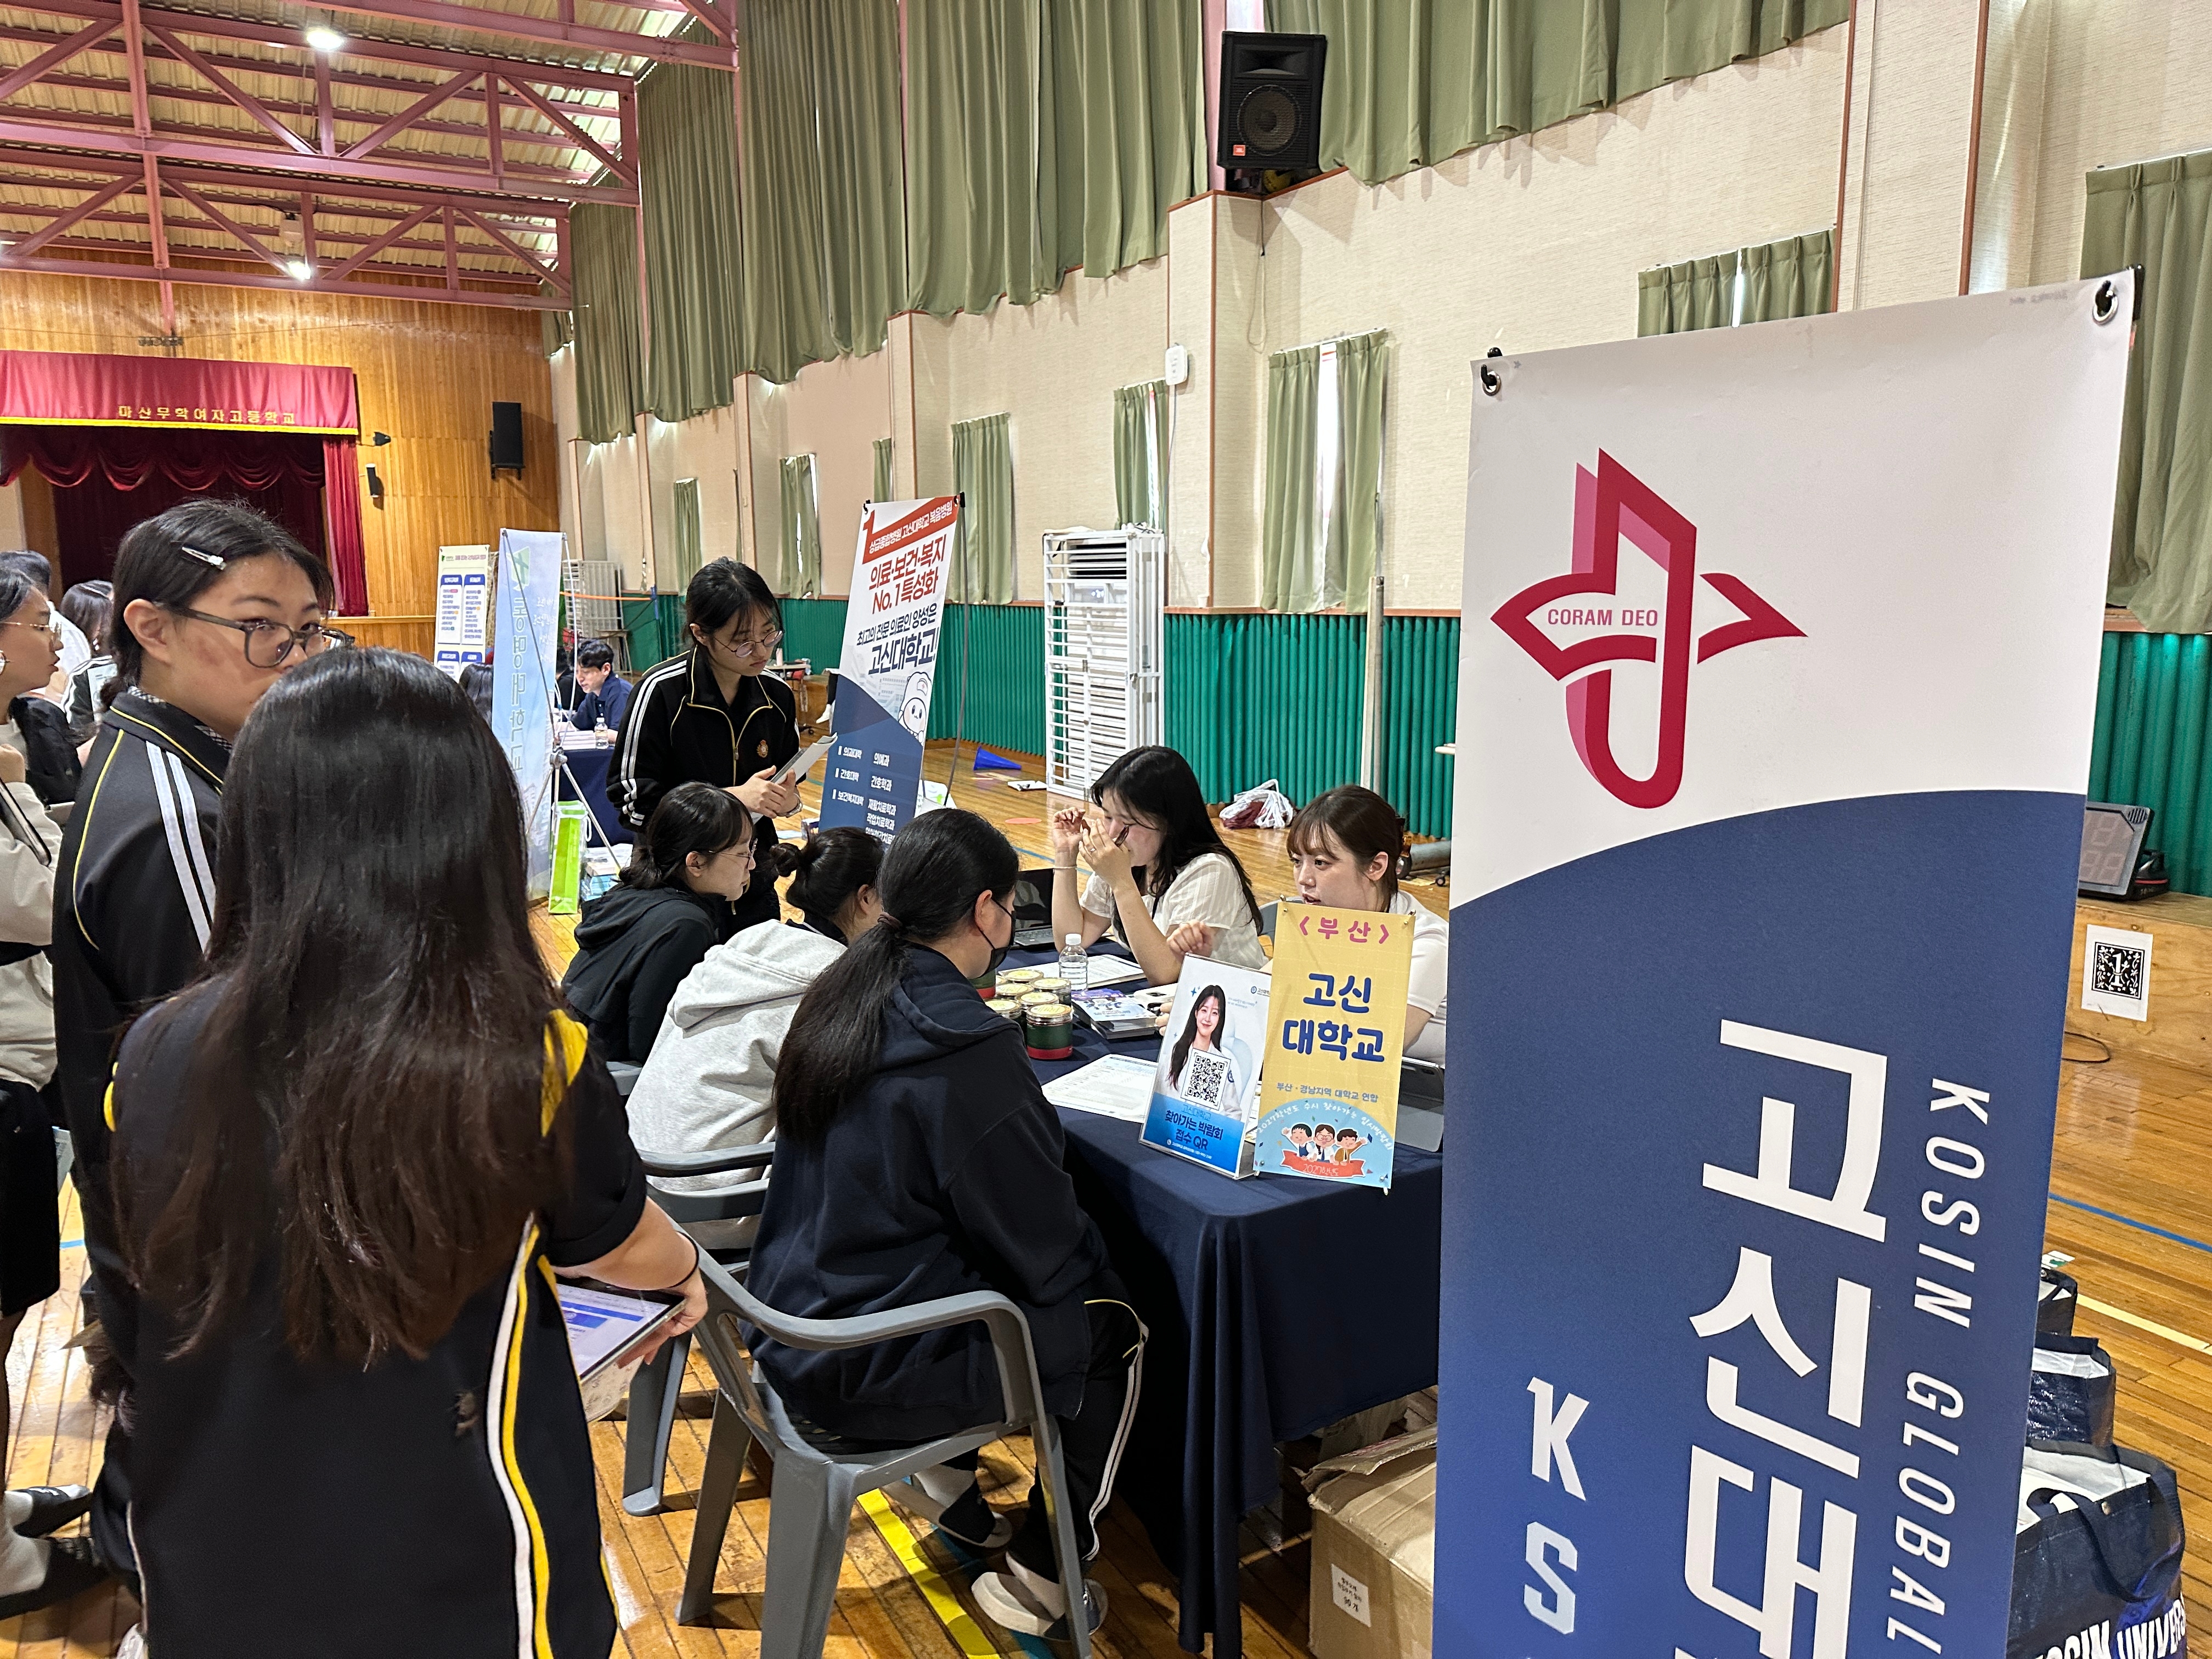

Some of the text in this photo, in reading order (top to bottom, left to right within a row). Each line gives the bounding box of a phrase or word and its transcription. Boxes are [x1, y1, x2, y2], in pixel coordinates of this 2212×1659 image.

[118, 405, 295, 424] 마산무학여자고등학교
[869, 500, 952, 554] 상급종합병원 고신대학교 복음병원
[856, 603, 937, 646] 최고의 전문 의료인 양성은
[1548, 609, 1658, 626] CORAM DEO
[868, 627, 939, 675] 고신대학교!
[843, 747, 862, 759] 의과대학
[873, 752, 890, 767] 의예과
[840, 769, 860, 782] 간호대학
[871, 776, 892, 792] 간호학과
[1303, 973, 1372, 1013] 고신
[1282, 1019, 1385, 1062] 대학교
[1277, 1082, 1293, 1092] 부산
[1300, 1084, 1331, 1097] 경남지역
[1335, 1090, 1359, 1099] 대학교
[1362, 1092, 1379, 1103] 연합
[1165, 1110, 1223, 1140] 찾아가는 박람회
[1181, 1104, 1211, 1121] 고신대학교
[1257, 1104, 1300, 1133] 2027학년도
[1305, 1102, 1319, 1110] 수시
[1323, 1102, 1357, 1119] 찾아가는
[1176, 1128, 1192, 1145] 접수
[1193, 1135, 1208, 1150] QR
[1302, 1164, 1339, 1176] 2027학년도
[1675, 1019, 1888, 1659] 고신대
[1886, 1077, 1990, 1655] KOSIN GLOBAL
[2033, 1619, 2112, 1659] SIN
